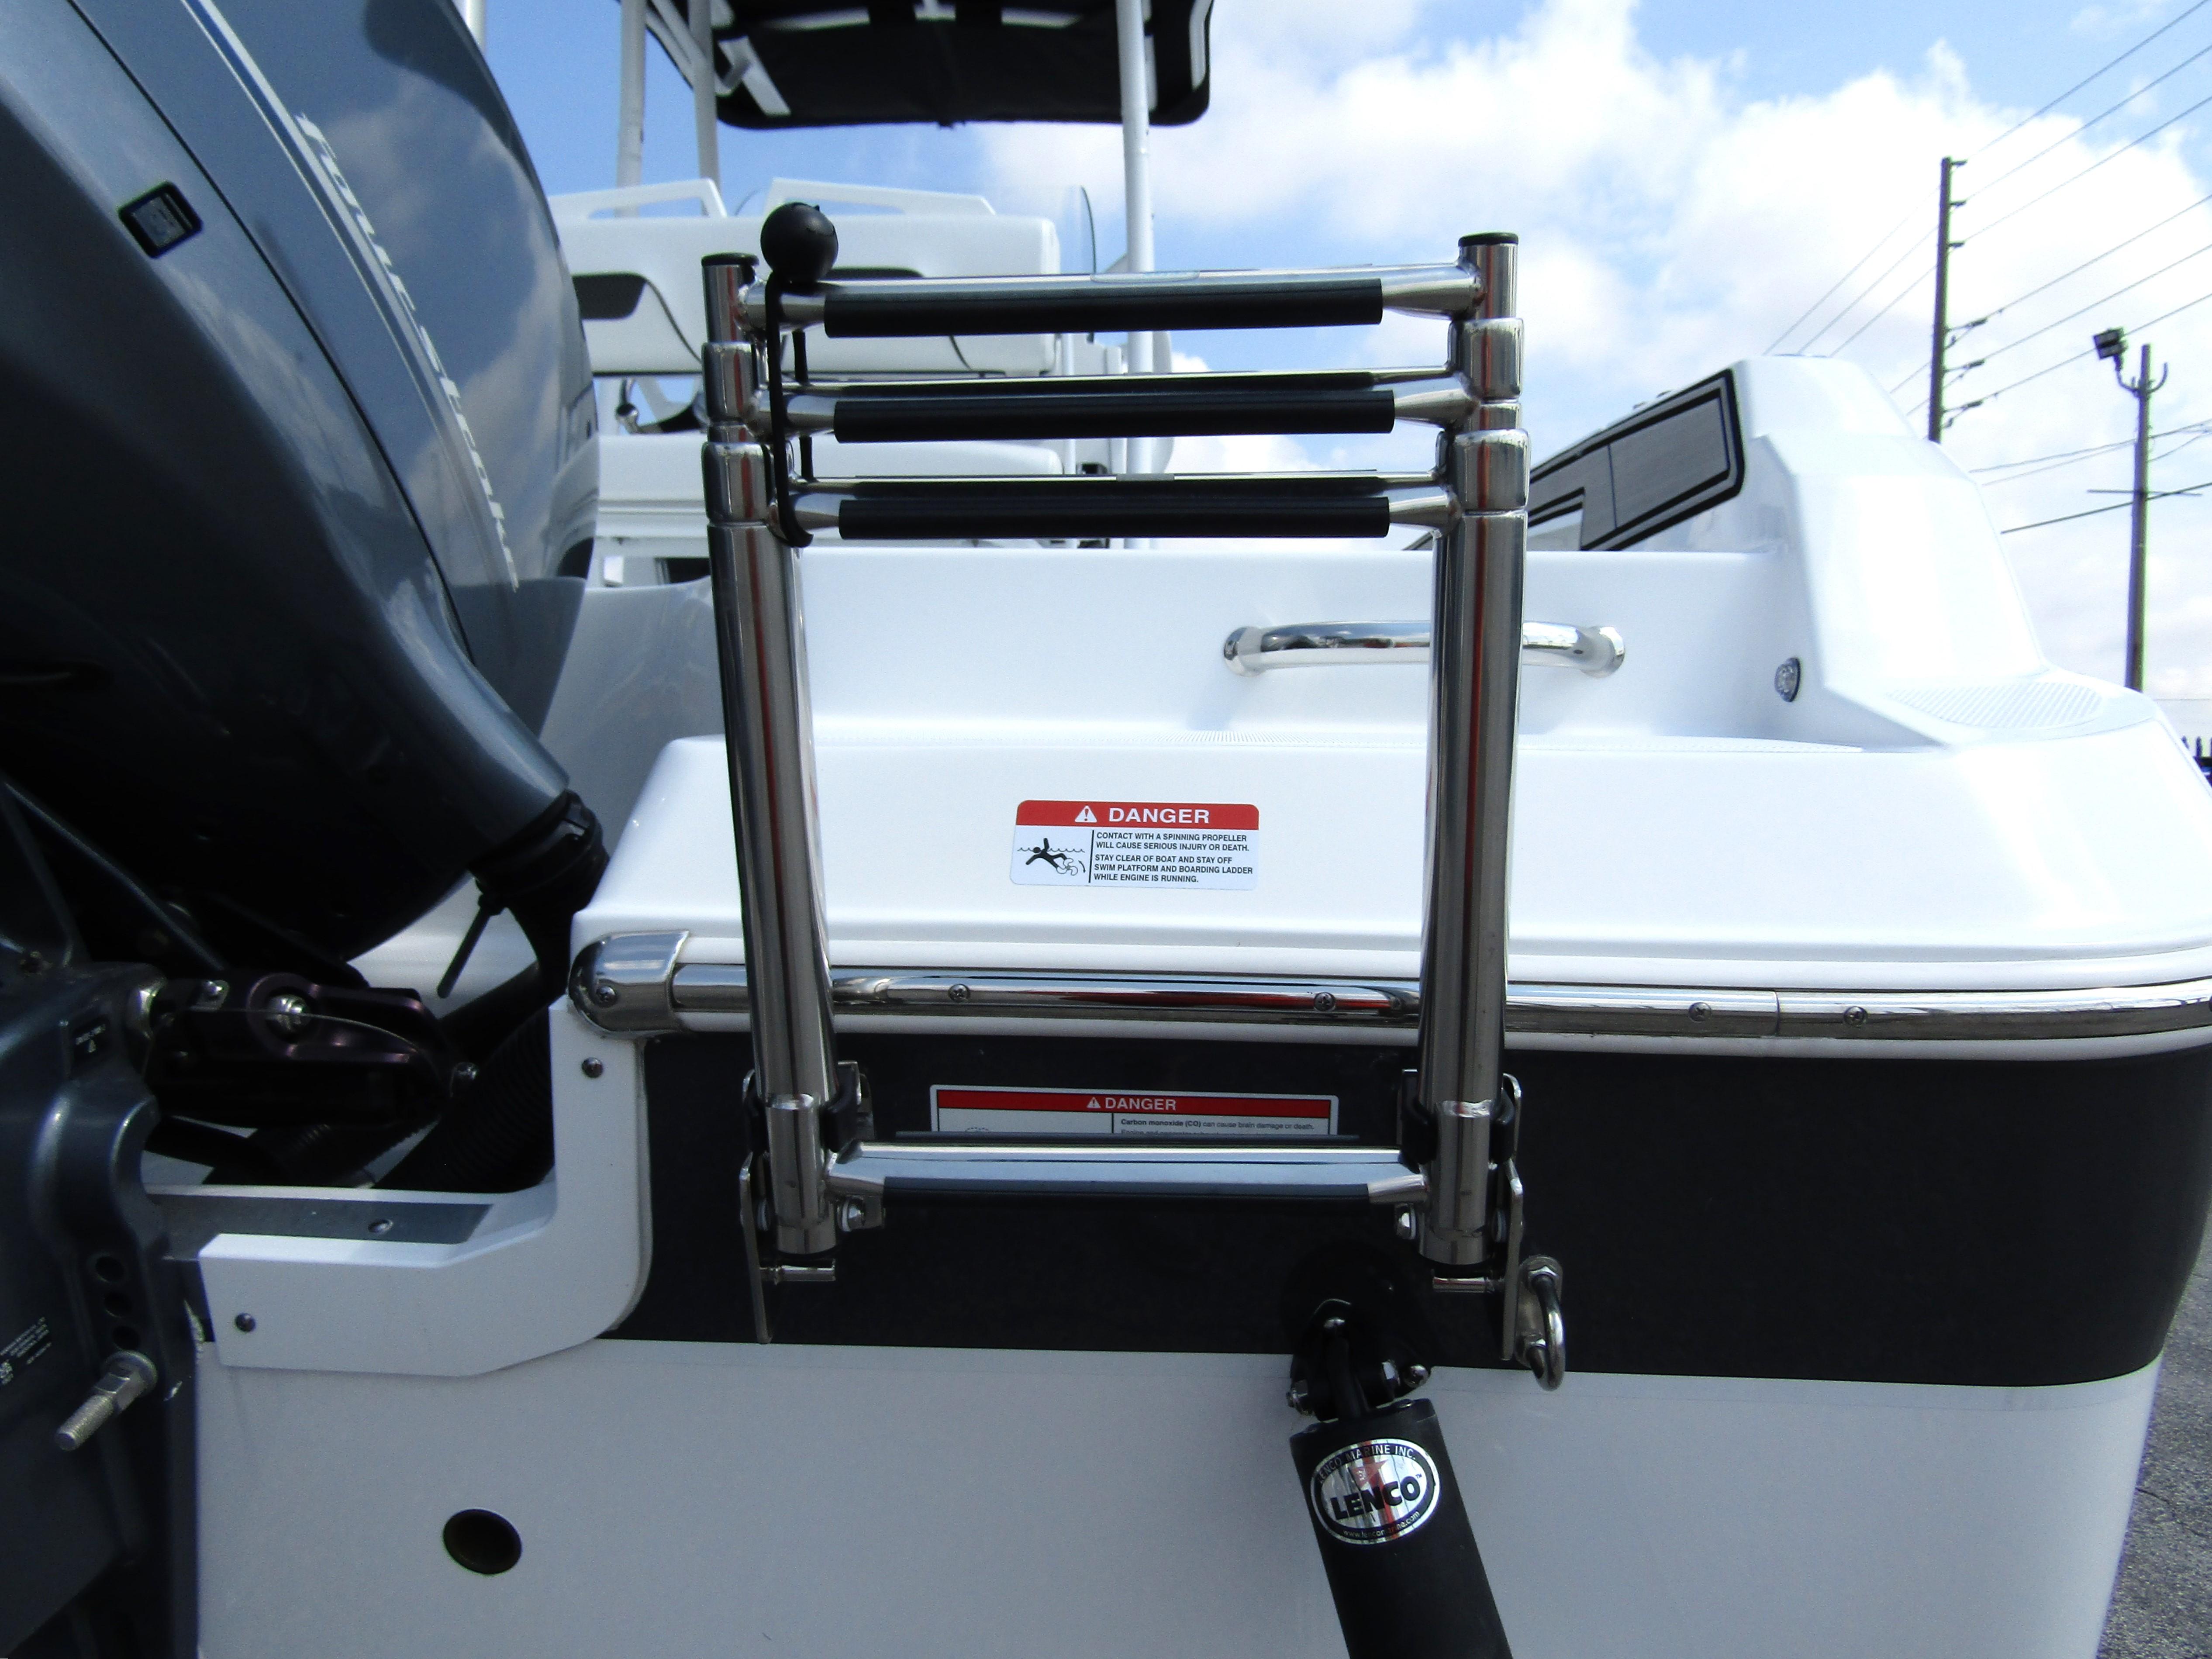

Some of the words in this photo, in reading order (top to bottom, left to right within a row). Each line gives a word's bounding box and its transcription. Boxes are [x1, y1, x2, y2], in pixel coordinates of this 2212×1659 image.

[1109, 808, 1209, 824] DANGER
[1105, 1097, 1176, 1111] DANGER
[1345, 1444, 1391, 1462] MARINE
[1394, 1445, 1416, 1460] INC.
[1330, 1476, 1421, 1520] LENCO
